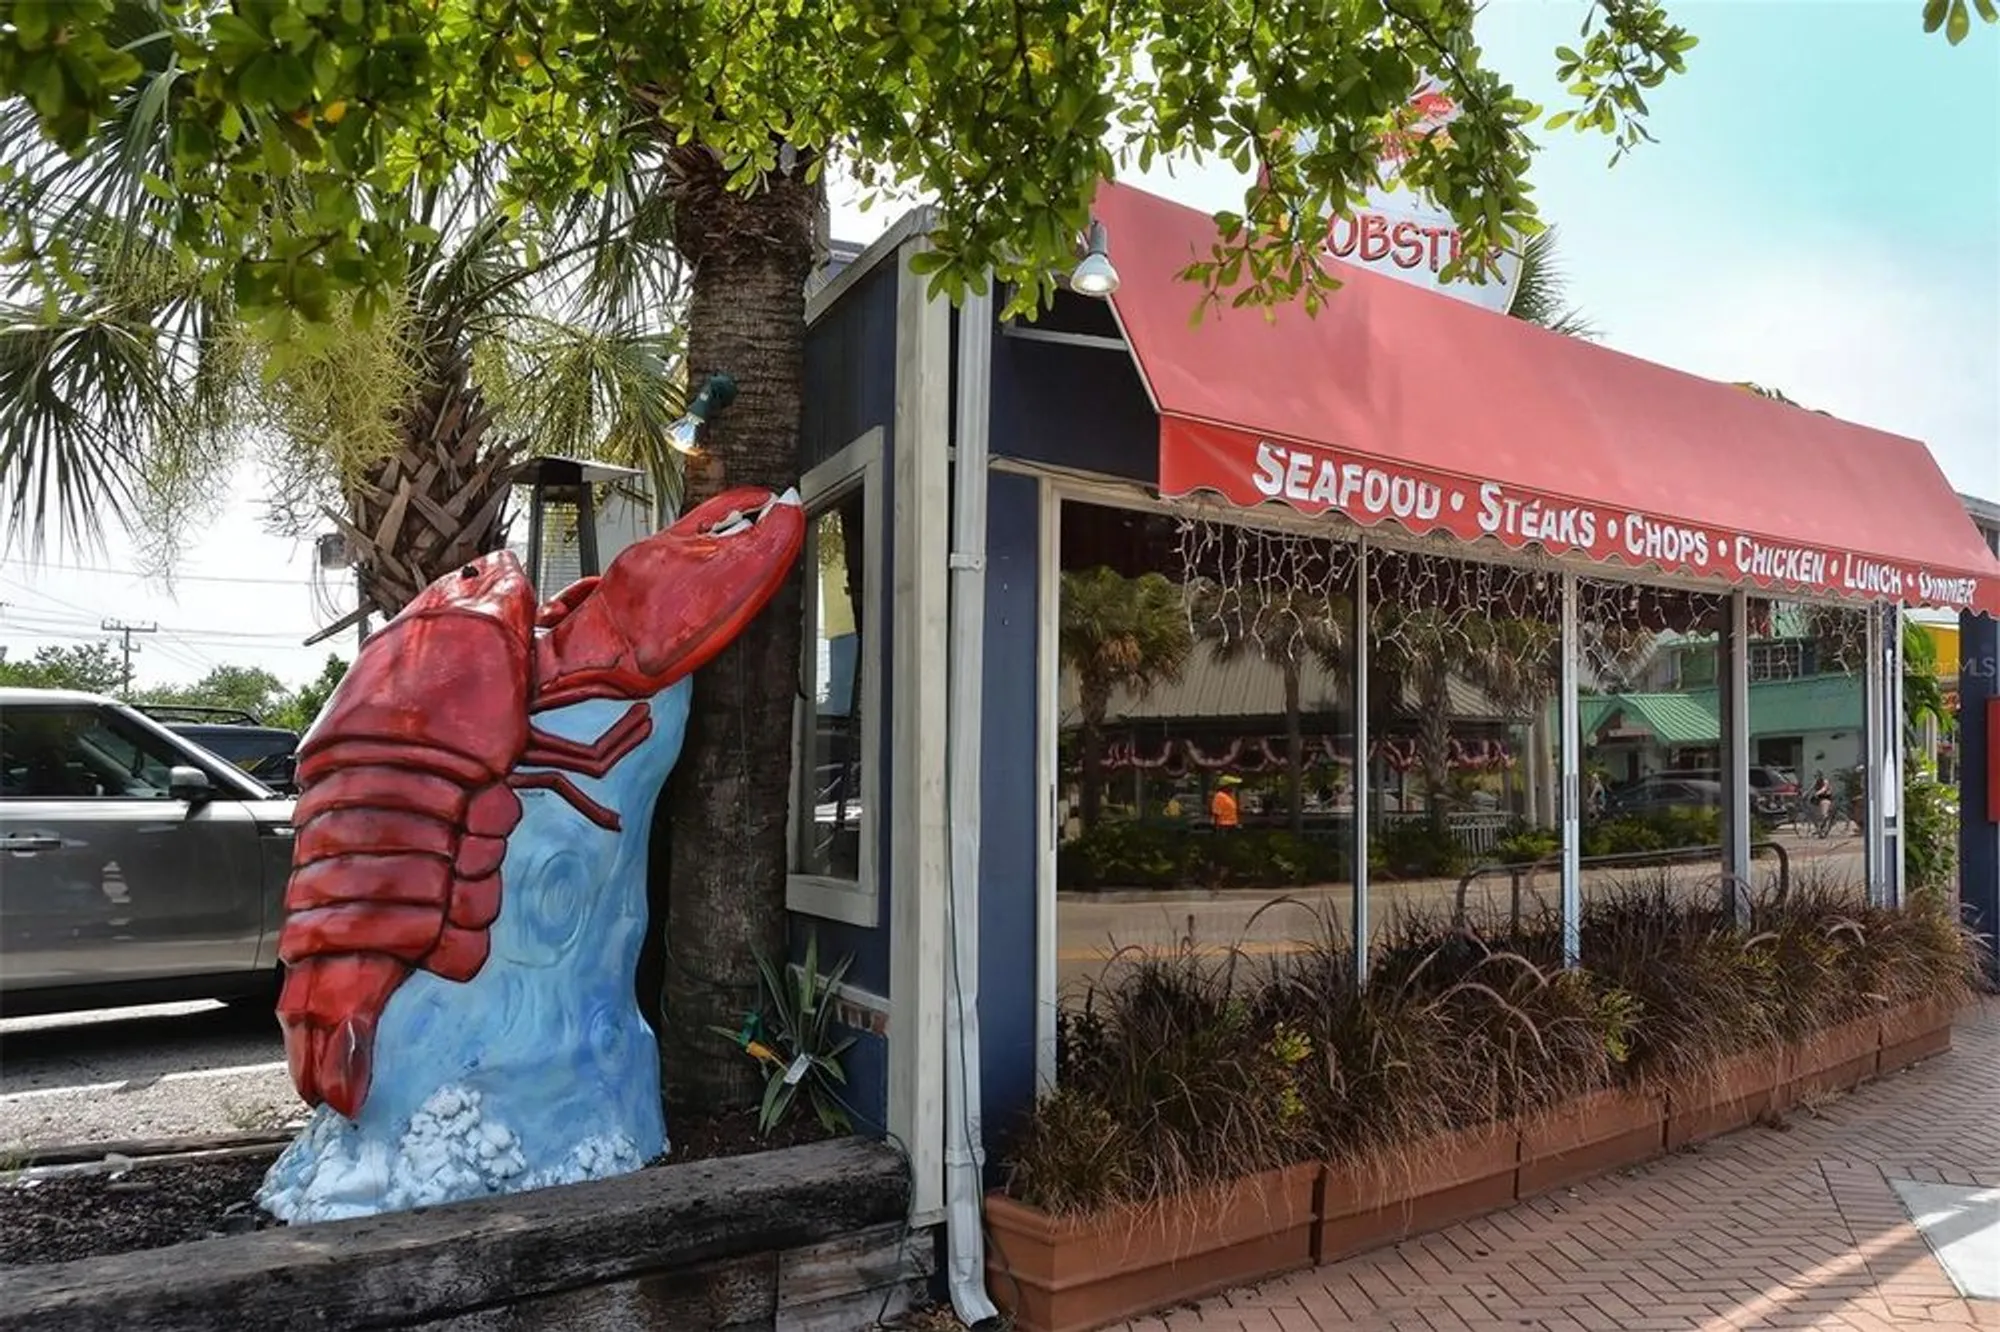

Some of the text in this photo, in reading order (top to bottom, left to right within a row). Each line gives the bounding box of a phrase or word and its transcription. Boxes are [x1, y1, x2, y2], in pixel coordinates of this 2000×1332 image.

[1316, 207, 1505, 285] OBST
[1252, 440, 1977, 605] SEAFOOD STEAKS CHOPS CHICKEN LUNCH DINNER
